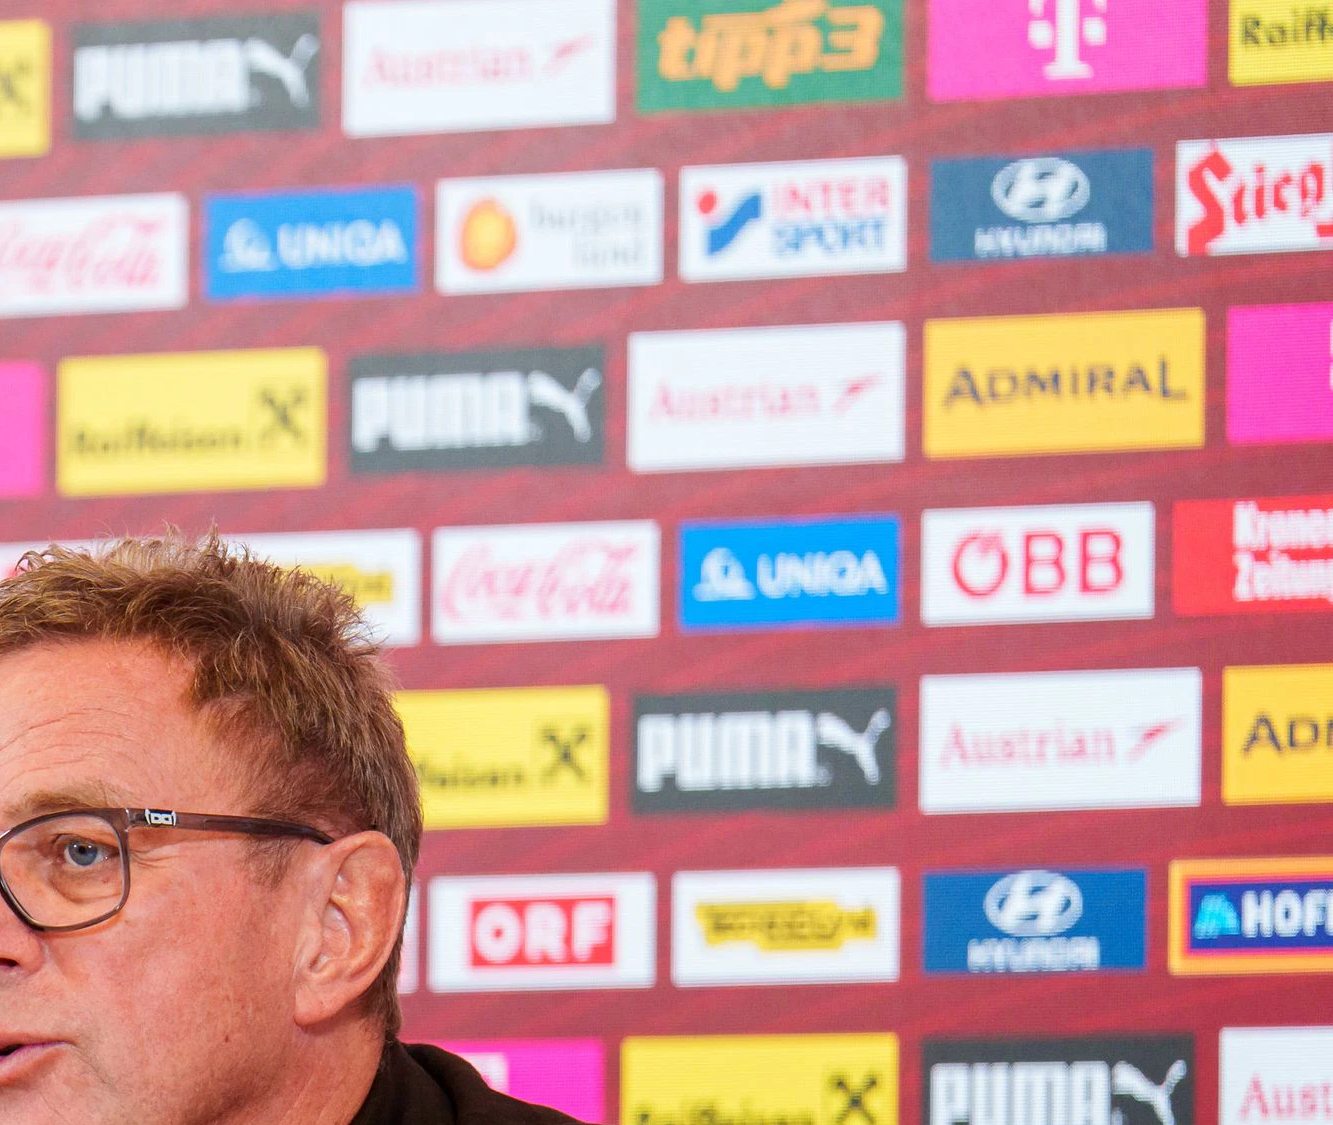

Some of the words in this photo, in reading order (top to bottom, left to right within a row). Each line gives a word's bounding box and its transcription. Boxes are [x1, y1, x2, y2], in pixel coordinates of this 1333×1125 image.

[945, 363, 1185, 405] ADMIRAL
[951, 528, 1124, 599] ÖBB
[638, 711, 819, 791] PUMA
[1244, 712, 1333, 753] AD
[471, 896, 614, 968] ORF
